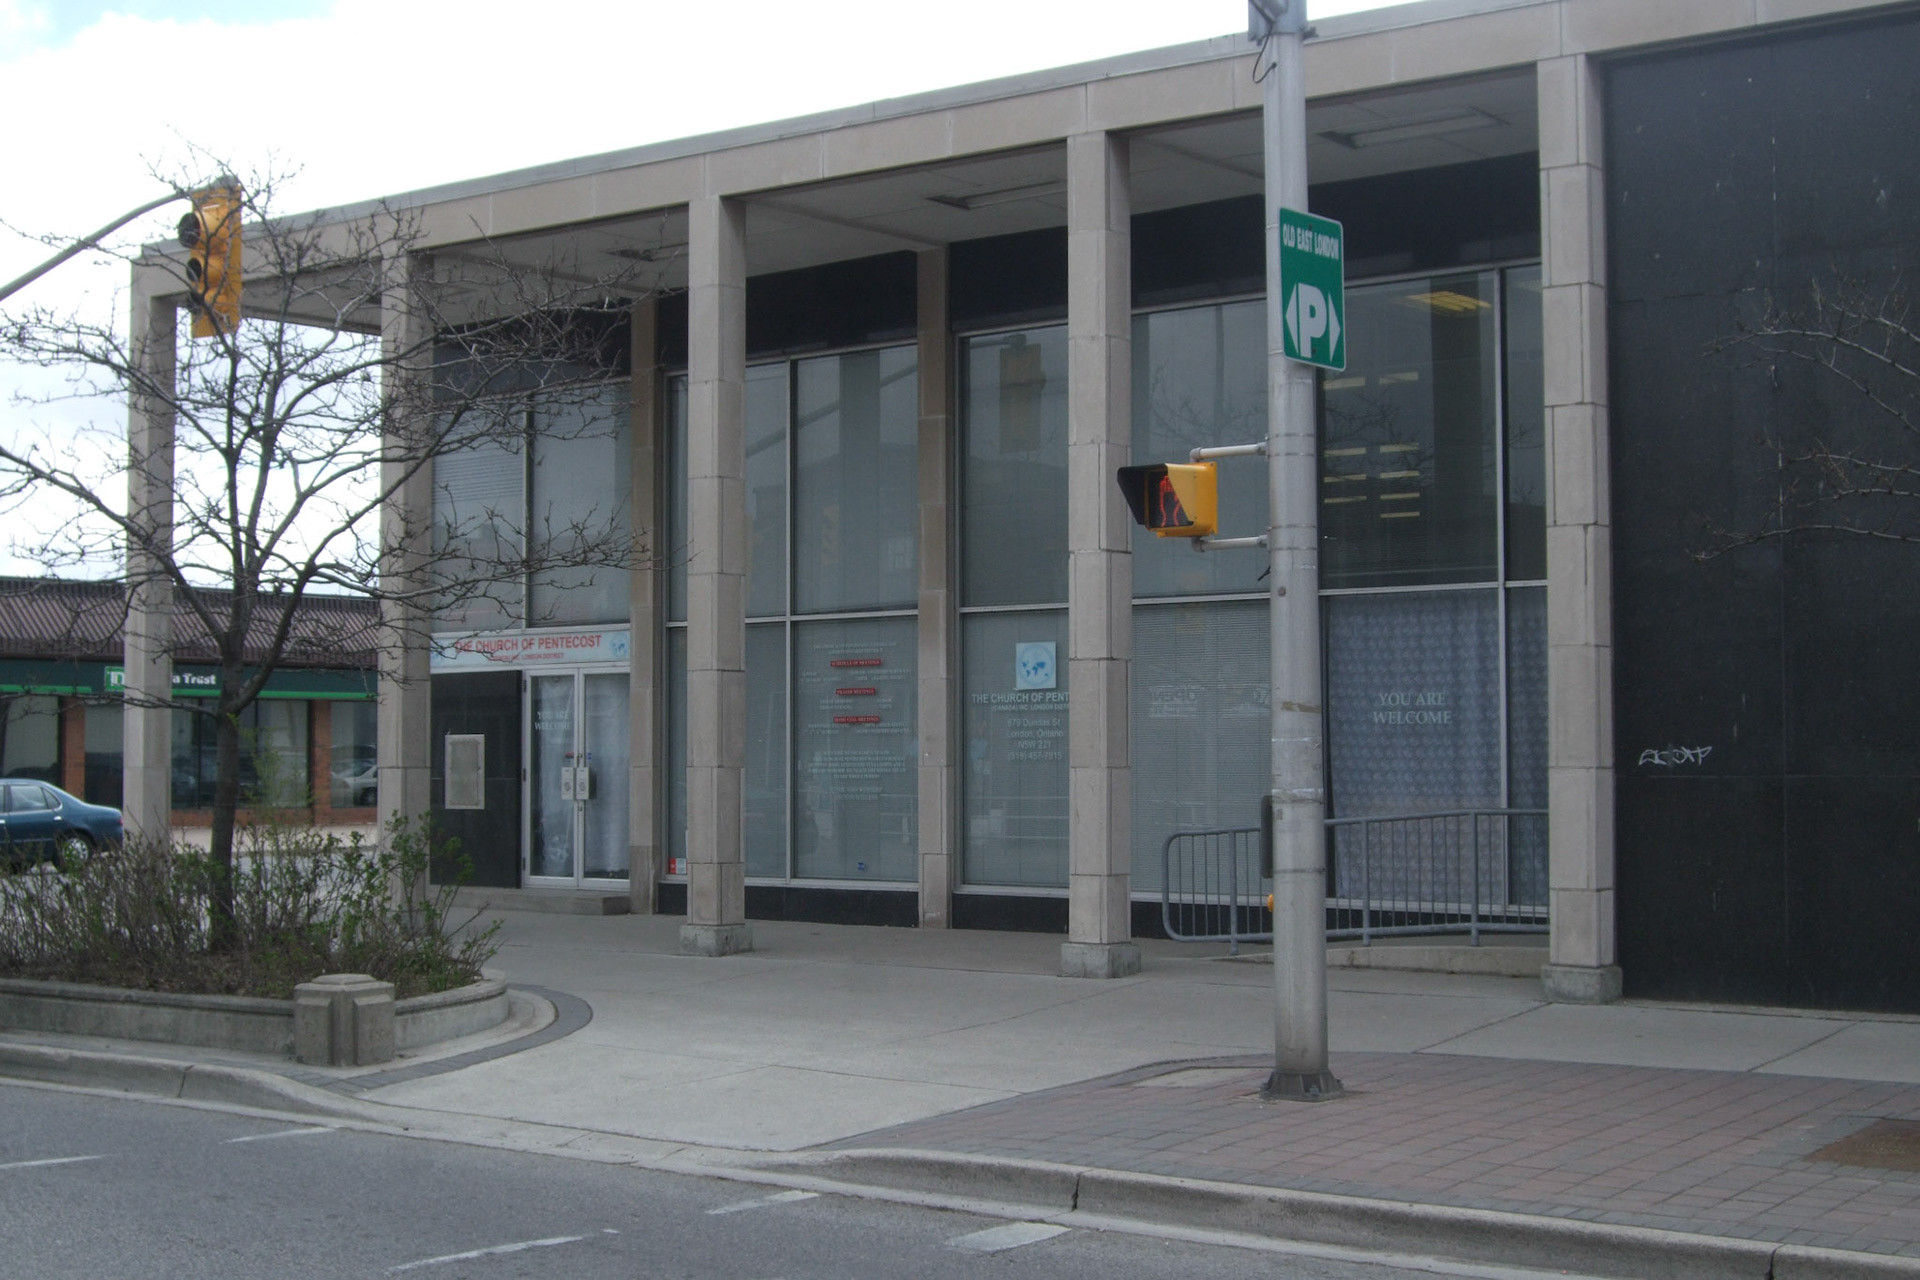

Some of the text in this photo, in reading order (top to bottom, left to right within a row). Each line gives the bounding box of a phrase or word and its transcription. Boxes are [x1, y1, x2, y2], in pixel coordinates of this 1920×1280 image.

[1283, 223, 1339, 260] OLD EAST LONDON
[1298, 282, 1327, 358] P
[455, 634, 602, 653] THE CHURCH OF PENTECOST
[183, 672, 216, 685] Trust
[972, 693, 989, 704] THE
[991, 692, 1029, 703] CHURCH
[1031, 692, 1044, 703] OF
[1378, 691, 1446, 706] YOU ARE
[1031, 703, 1054, 711] LONDON
[537, 711, 552, 720] YOU
[1373, 710, 1453, 725] WELCOME
[535, 721, 571, 731] WELCOME
[1023, 717, 1050, 727] Dundas
[1036, 728, 1064, 738] Ontario
[1018, 740, 1036, 749] N5W
